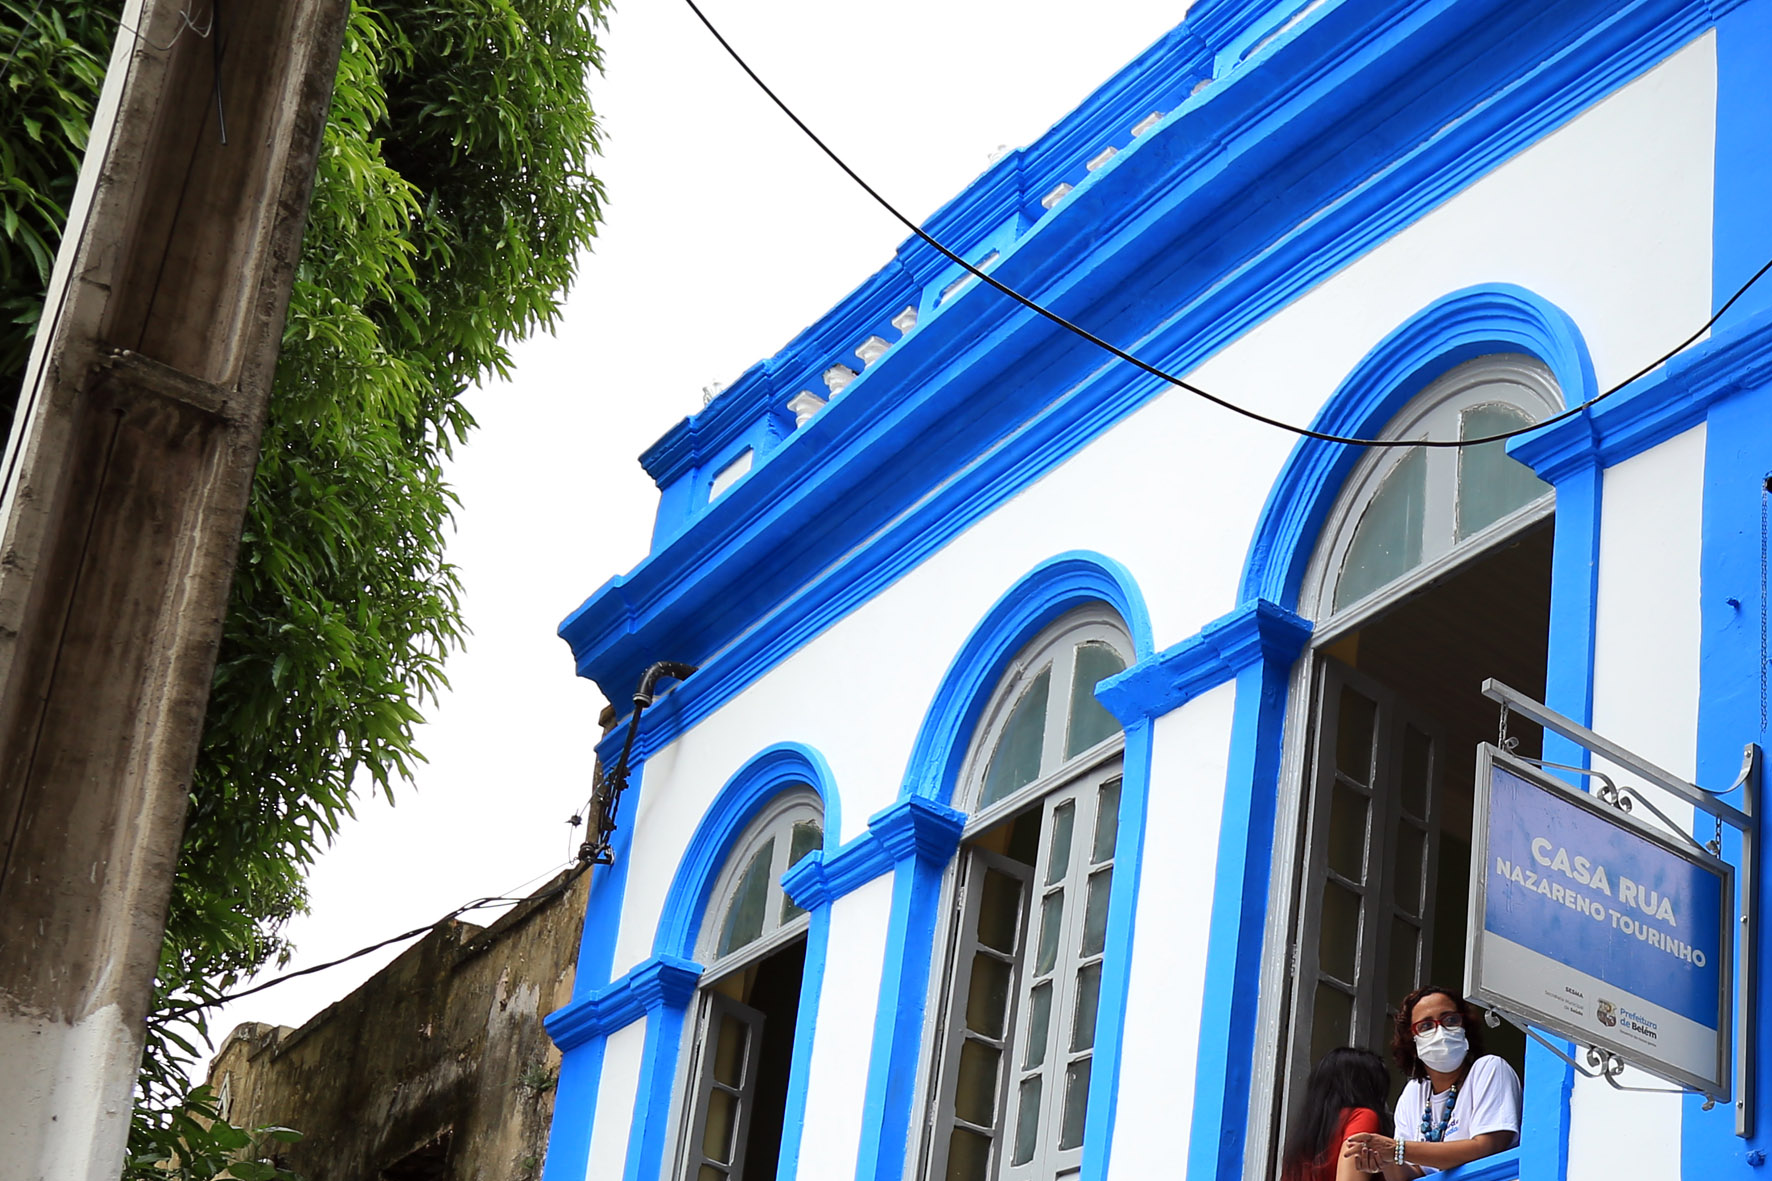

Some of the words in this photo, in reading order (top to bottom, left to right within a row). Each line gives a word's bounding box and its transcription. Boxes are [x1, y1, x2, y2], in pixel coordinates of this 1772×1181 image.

[1531, 837, 1612, 897] CASA
[1619, 875, 1677, 928] RUA
[1496, 856, 1606, 922] NAZARENO
[1608, 908, 1706, 968] TOURINHO
[1620, 1007, 1658, 1030] Prefeitura
[1620, 1018, 1631, 1029] de
[1631, 1022, 1658, 1039] Belém
